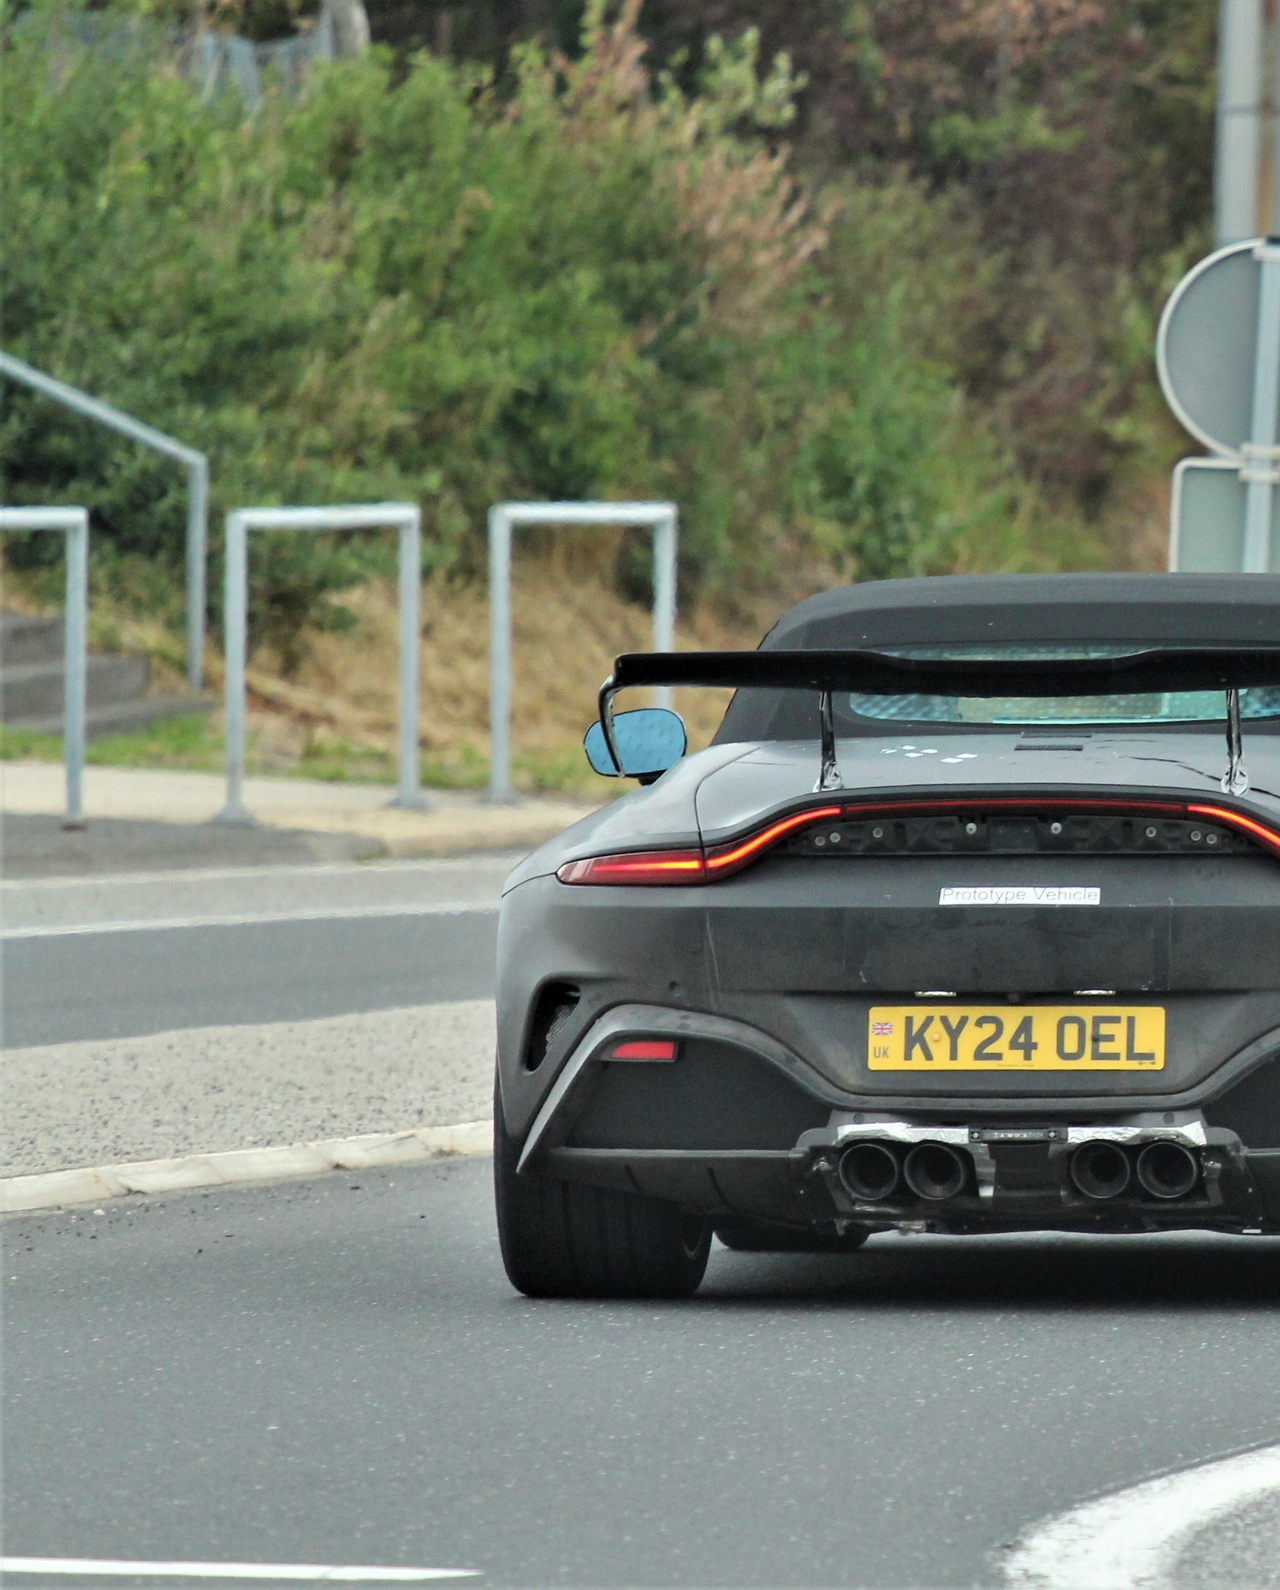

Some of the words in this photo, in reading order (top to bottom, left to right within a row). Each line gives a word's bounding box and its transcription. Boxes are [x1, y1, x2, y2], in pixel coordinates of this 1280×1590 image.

[942, 887, 1026, 904] Prototype
[1034, 887, 1098, 900] Vehicle
[903, 1015, 1038, 1061] KY24
[1056, 1015, 1155, 1061] OEL
[873, 1046, 889, 1058] UK
